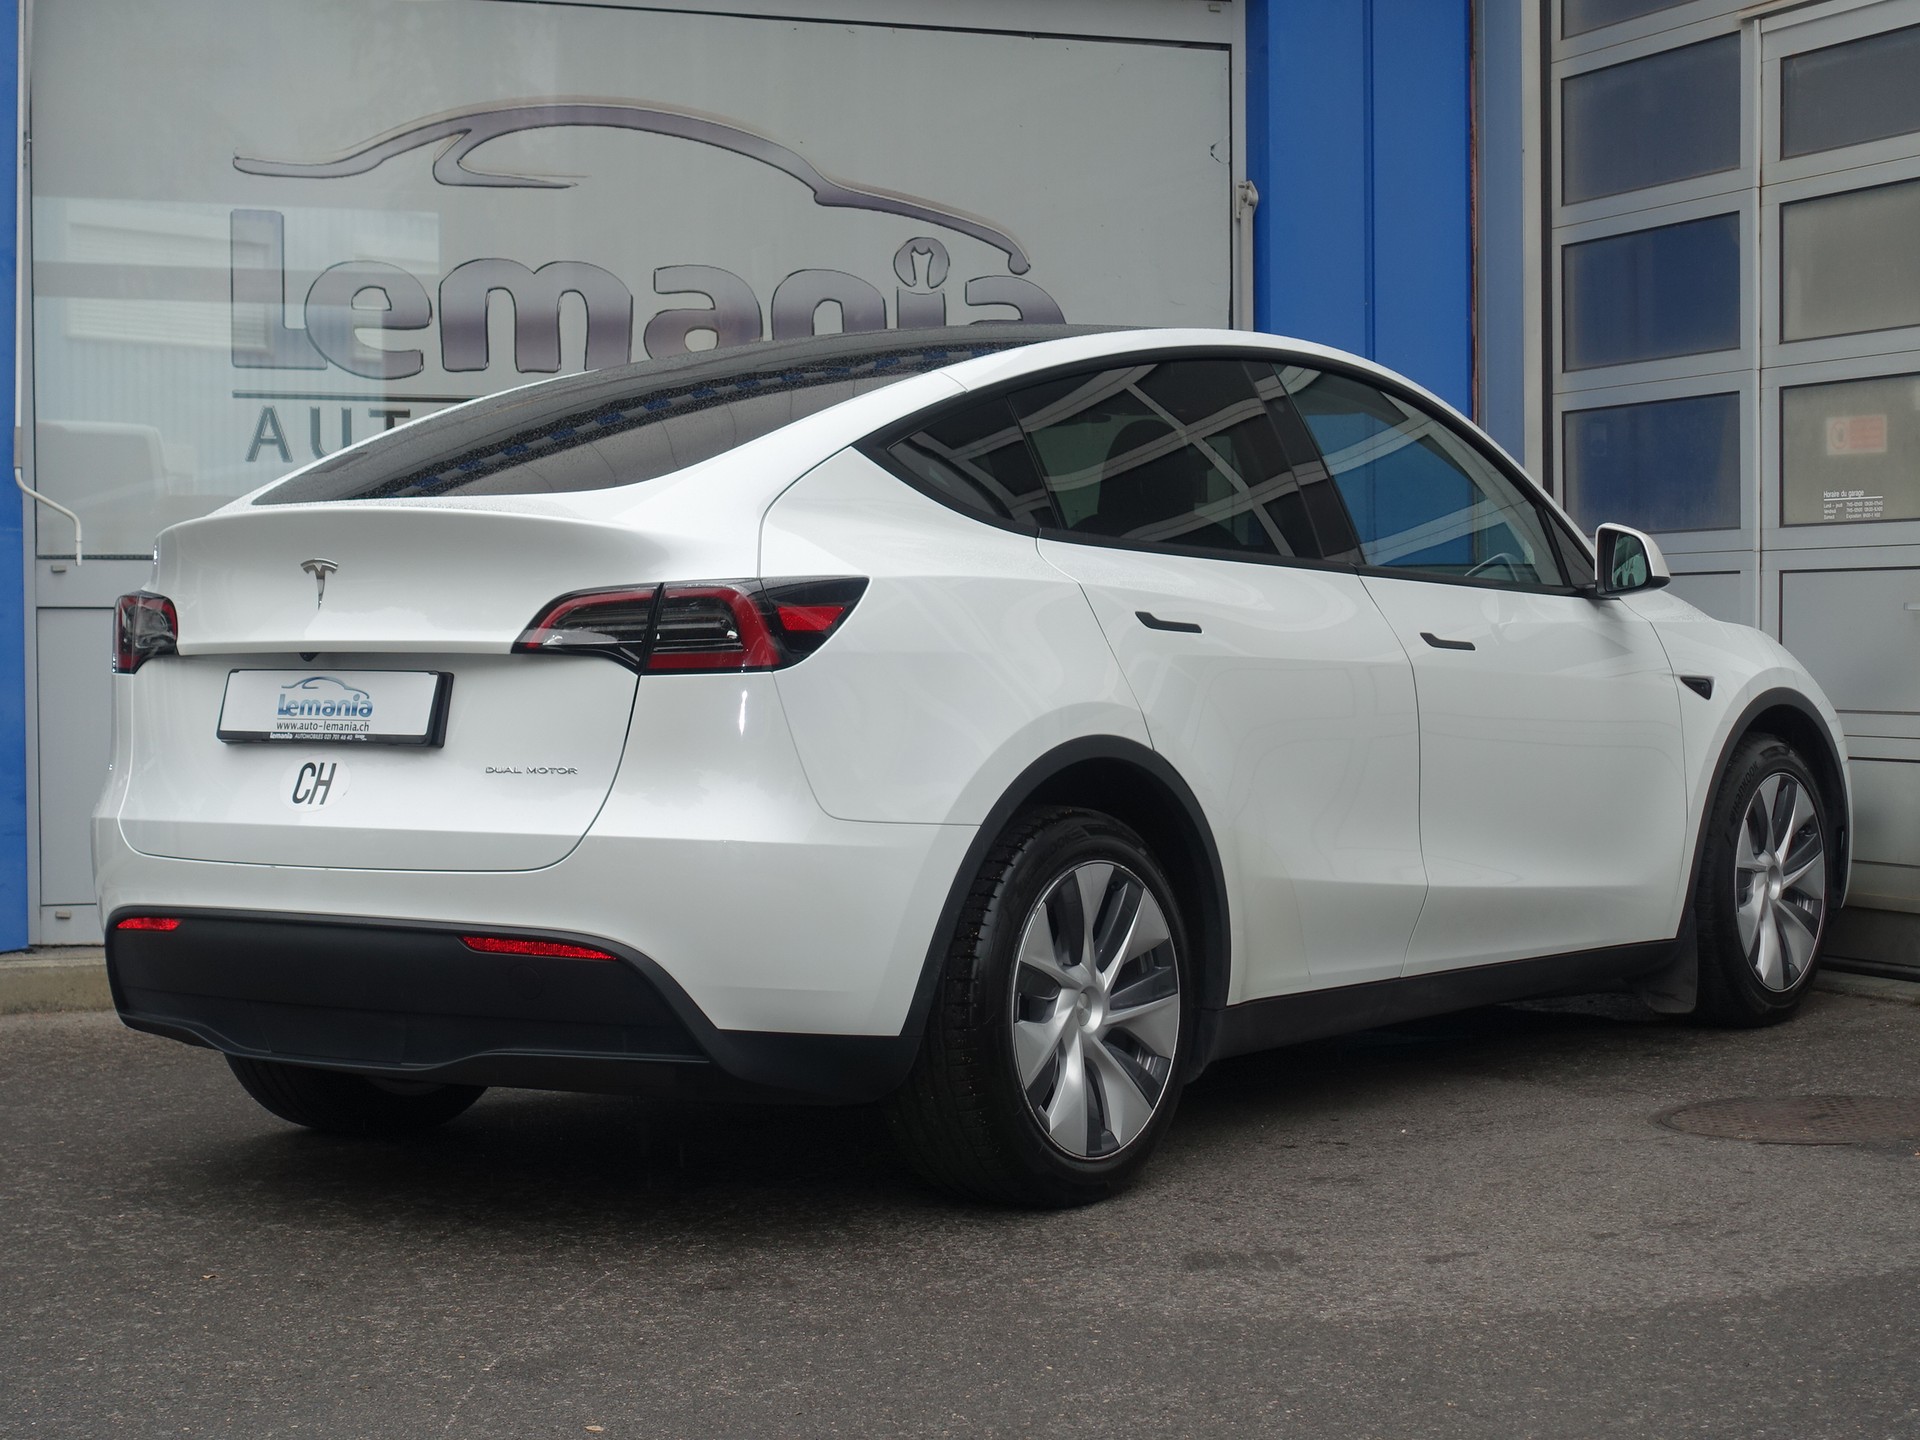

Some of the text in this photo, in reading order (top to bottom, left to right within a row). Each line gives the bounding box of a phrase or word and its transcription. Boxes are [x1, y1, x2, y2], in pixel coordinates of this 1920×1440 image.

[277, 693, 373, 718] Lemania
[276, 721, 370, 732] www.auto-lemania.ch
[485, 766, 578, 775] DUAL MOTOR
[292, 762, 338, 805] CH
